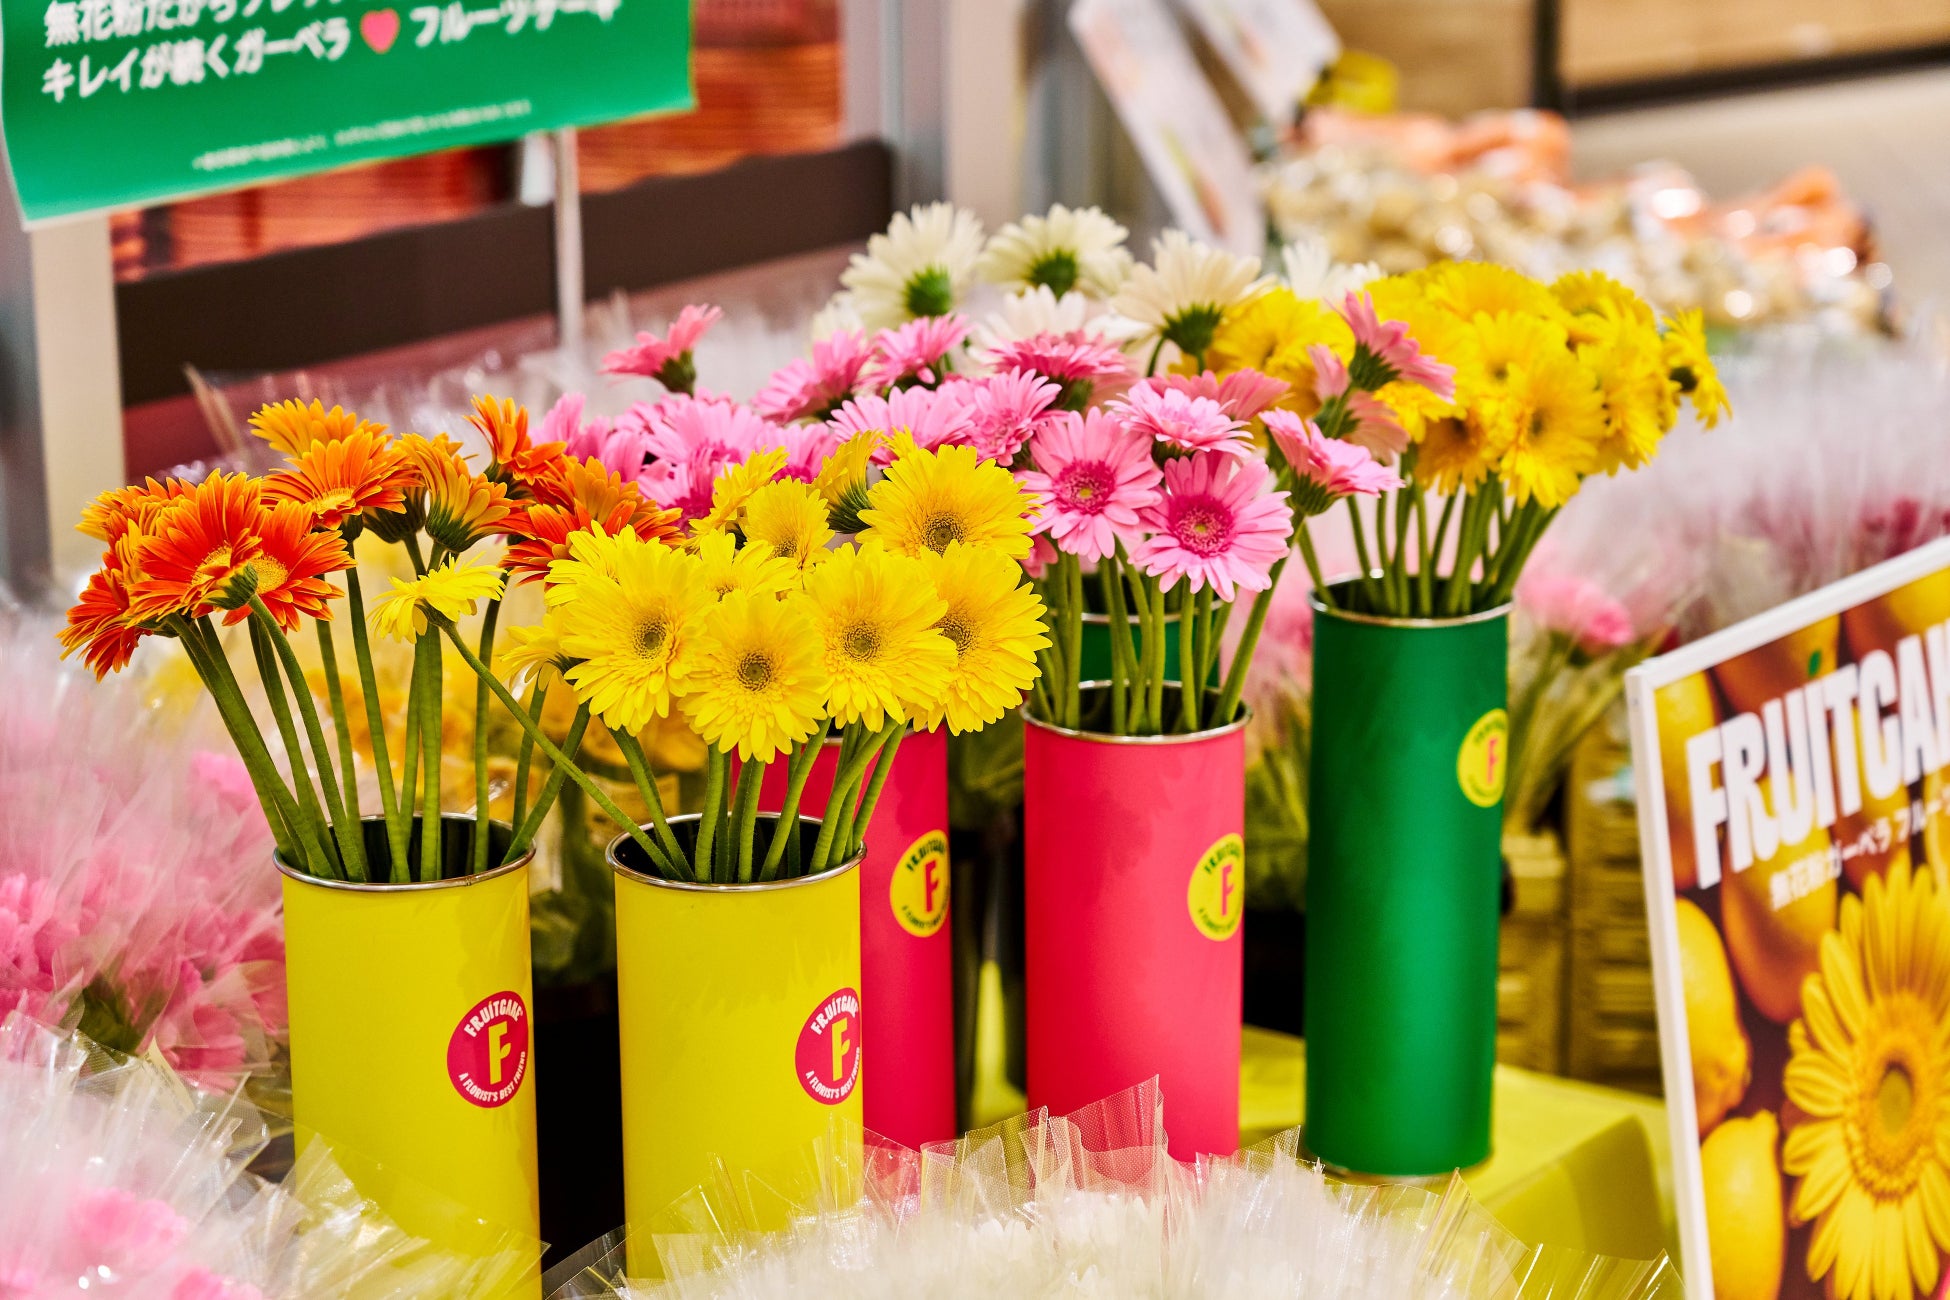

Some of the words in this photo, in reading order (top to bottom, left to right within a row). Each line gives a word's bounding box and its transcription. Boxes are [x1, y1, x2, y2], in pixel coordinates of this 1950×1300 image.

[488, 1021, 511, 1085] F
[832, 1017, 851, 1082] F
[458, 1072, 469, 1082] A
[514, 1051, 526, 1085] FRIEND
[805, 1070, 815, 1080] A
[463, 1078, 499, 1102] FLORIST'S
[499, 1081, 515, 1100] BEST
[809, 1076, 840, 1099] FLORIST'S
